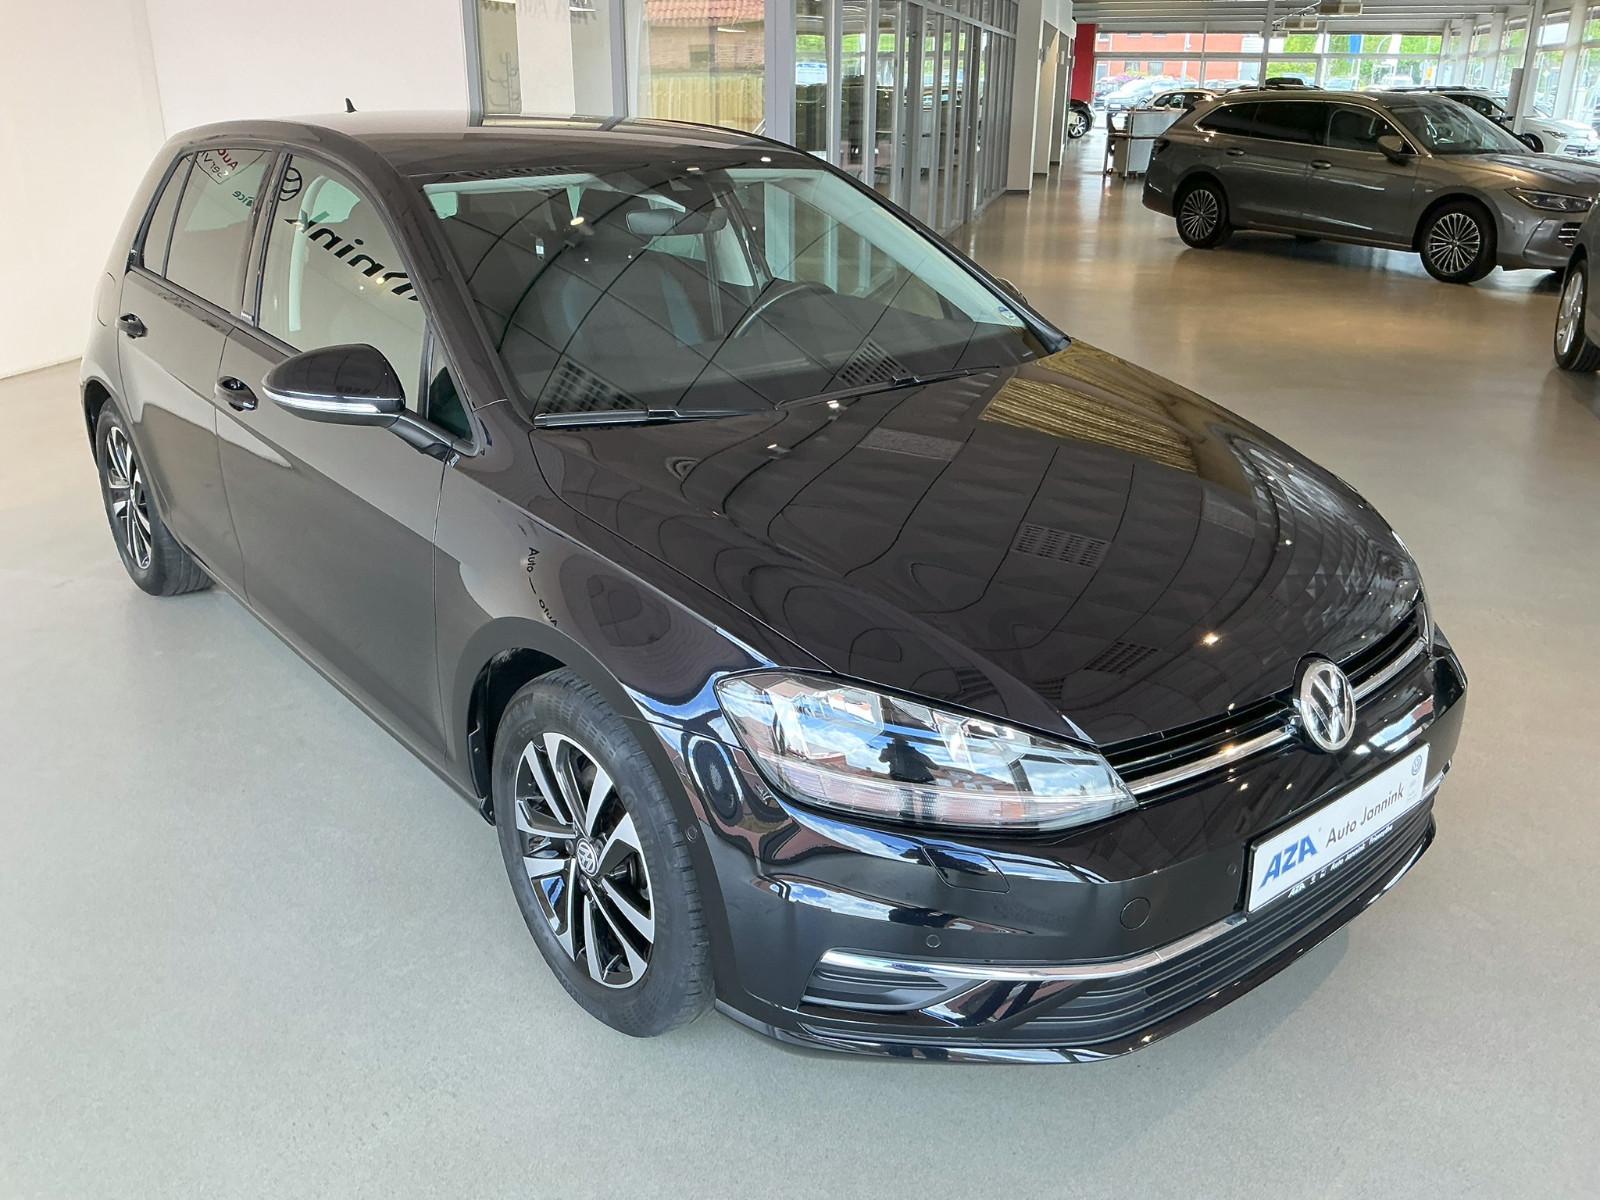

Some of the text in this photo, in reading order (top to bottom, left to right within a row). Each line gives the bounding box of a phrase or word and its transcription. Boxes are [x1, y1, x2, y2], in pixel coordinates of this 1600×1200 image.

[1259, 834, 1318, 889] AZA
[1325, 826, 1357, 849] Auto
[1360, 783, 1405, 826] Jannink
